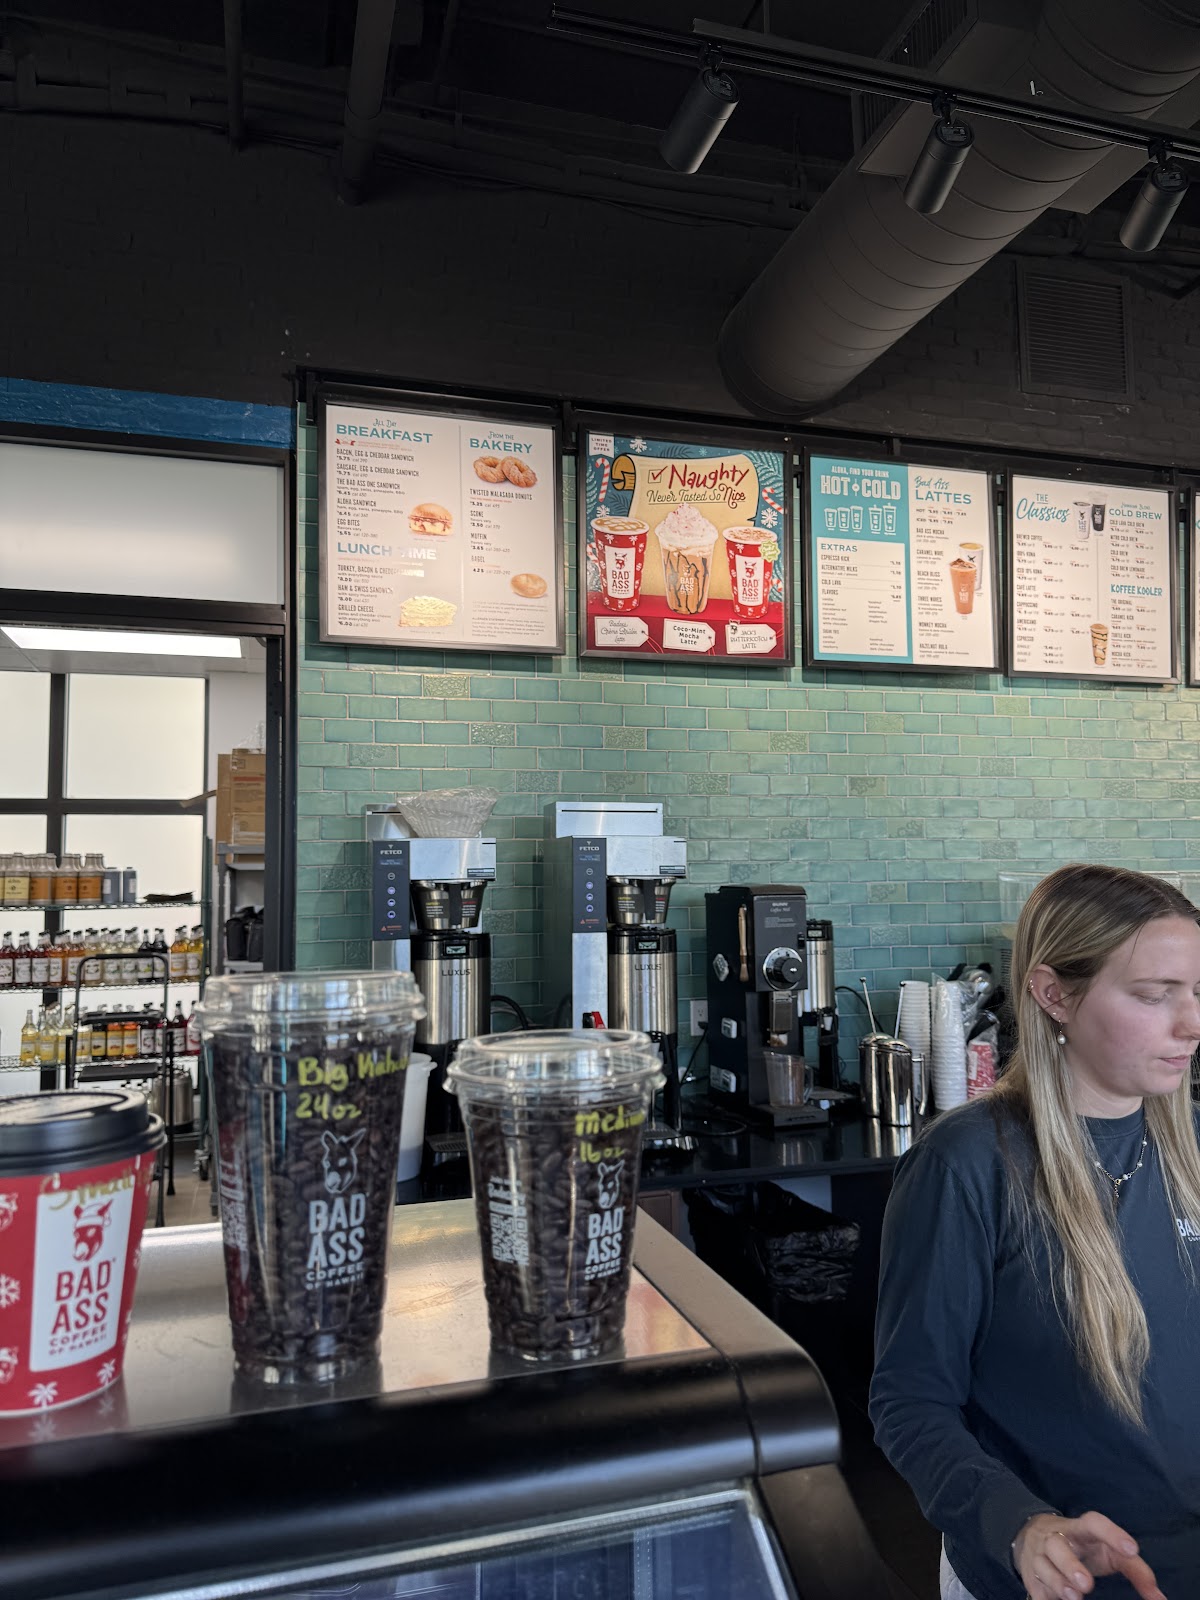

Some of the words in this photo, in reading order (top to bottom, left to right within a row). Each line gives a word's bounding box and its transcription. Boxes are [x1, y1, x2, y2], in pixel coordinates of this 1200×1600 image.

[336, 424, 432, 443] BREAKFAST
[470, 438, 533, 454] BAKERY
[337, 448, 354, 456] BACON,
[370, 451, 390, 460] CHEDDAR
[391, 454, 414, 462] SANDWICH
[337, 463, 358, 472] SAUSAGE,
[374, 467, 395, 475] CHEDDAR
[396, 469, 419, 477] SANDWICH
[668, 463, 750, 490] Naughty
[831, 466, 848, 475] ALOHA,
[850, 467, 860, 475] FIND
[367, 480, 376, 488] ONE
[376, 482, 400, 490] SANDWICH
[820, 475, 850, 496] HOT
[862, 478, 901, 500] COLD
[915, 476, 932, 488] Bad
[934, 478, 950, 490] Ass
[470, 488, 489, 498] TWISTED
[490, 490, 514, 499] MALASADA
[515, 492, 532, 500] DONUTS
[647, 489, 677, 503] Never
[678, 489, 707, 503] Tasted
[708, 488, 721, 501] So
[719, 483, 746, 508] Nice
[916, 489, 972, 504] LATTES
[1036, 494, 1048, 502] THE
[337, 498, 352, 506] ALOHA
[353, 499, 376, 507] SANDWICH
[470, 510, 484, 518] SCONE
[1016, 498, 1070, 523] Classics
[1109, 509, 1133, 517] COLD
[1136, 511, 1162, 520] BREW
[470, 532, 487, 540] MUFFIN
[337, 542, 392, 556] LUNCH
[821, 543, 858, 552] EXTRAS
[338, 565, 357, 573] TURKEY,
[611, 570, 629, 580] BAD
[821, 564, 845, 572] ALTERNATIVE
[611, 579, 629, 589] ASS
[680, 577, 694, 585] BAD
[742, 579, 759, 588] BAD
[741, 587, 759, 597] ASS
[1111, 584, 1135, 594] KOFFEE
[1137, 586, 1162, 596] KOOLER
[672, 625, 706, 634] Coco-Mint
[296, 1056, 349, 1092] Big
[308, 1193, 366, 1234] BAD
[588, 1208, 624, 1239] BAD
[307, 1226, 365, 1269] ASS
[585, 1233, 621, 1265] ASS
[306, 1262, 364, 1282] COFFEE
[585, 1260, 621, 1274] COFFEE
[598, 1266, 620, 1278] HAWAII
[55, 1260, 111, 1302] BAD
[305, 1282, 322, 1290] OF
[326, 1273, 364, 1288] HAWAII
[51, 1291, 110, 1336] ASS
[50, 1323, 107, 1347] COFFEE
[48, 1348, 64, 1357] OF
[69, 1334, 107, 1353] HAWAII
